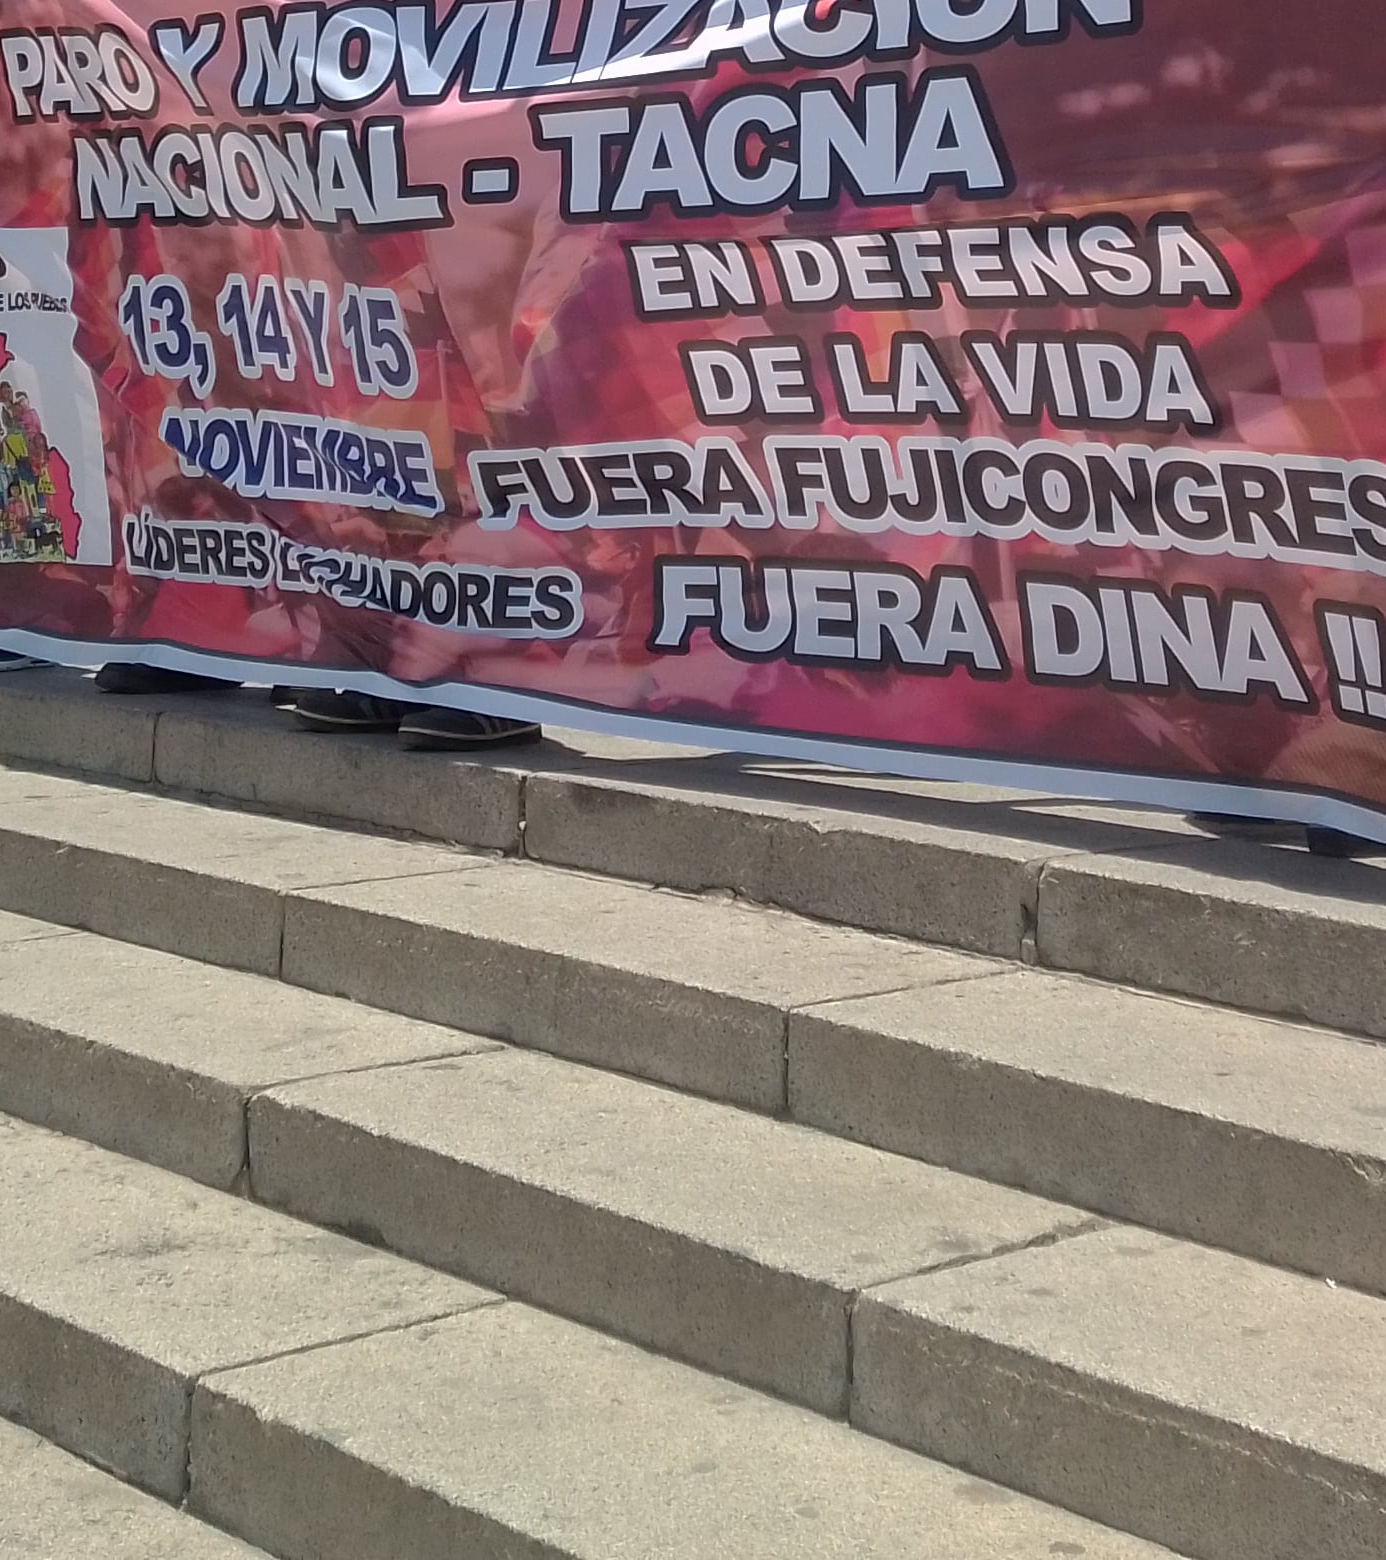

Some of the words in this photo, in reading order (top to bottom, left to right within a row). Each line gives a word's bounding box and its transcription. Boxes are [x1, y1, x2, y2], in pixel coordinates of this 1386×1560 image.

[1, 28, 156, 117] PARO
[155, 20, 222, 108] Y
[74, 124, 442, 224] NACIONAL
[540, 76, 1007, 214] TACNA
[634, 241, 757, 311] EN
[780, 223, 1231, 304] DEFENSA
[123, 282, 211, 388] 13,
[223, 281, 290, 373] 14
[292, 288, 330, 378] Y
[343, 287, 412, 391] 15
[689, 344, 817, 419] DE
[833, 341, 962, 418] LA
[977, 341, 1215, 426] VIDA
[163, 412, 438, 510] NOVIEMBRE
[479, 447, 771, 525] FUERA
[125, 514, 271, 580] LÍDERES
[659, 564, 1005, 670] FUERA
[1026, 582, 1312, 705] DINA
